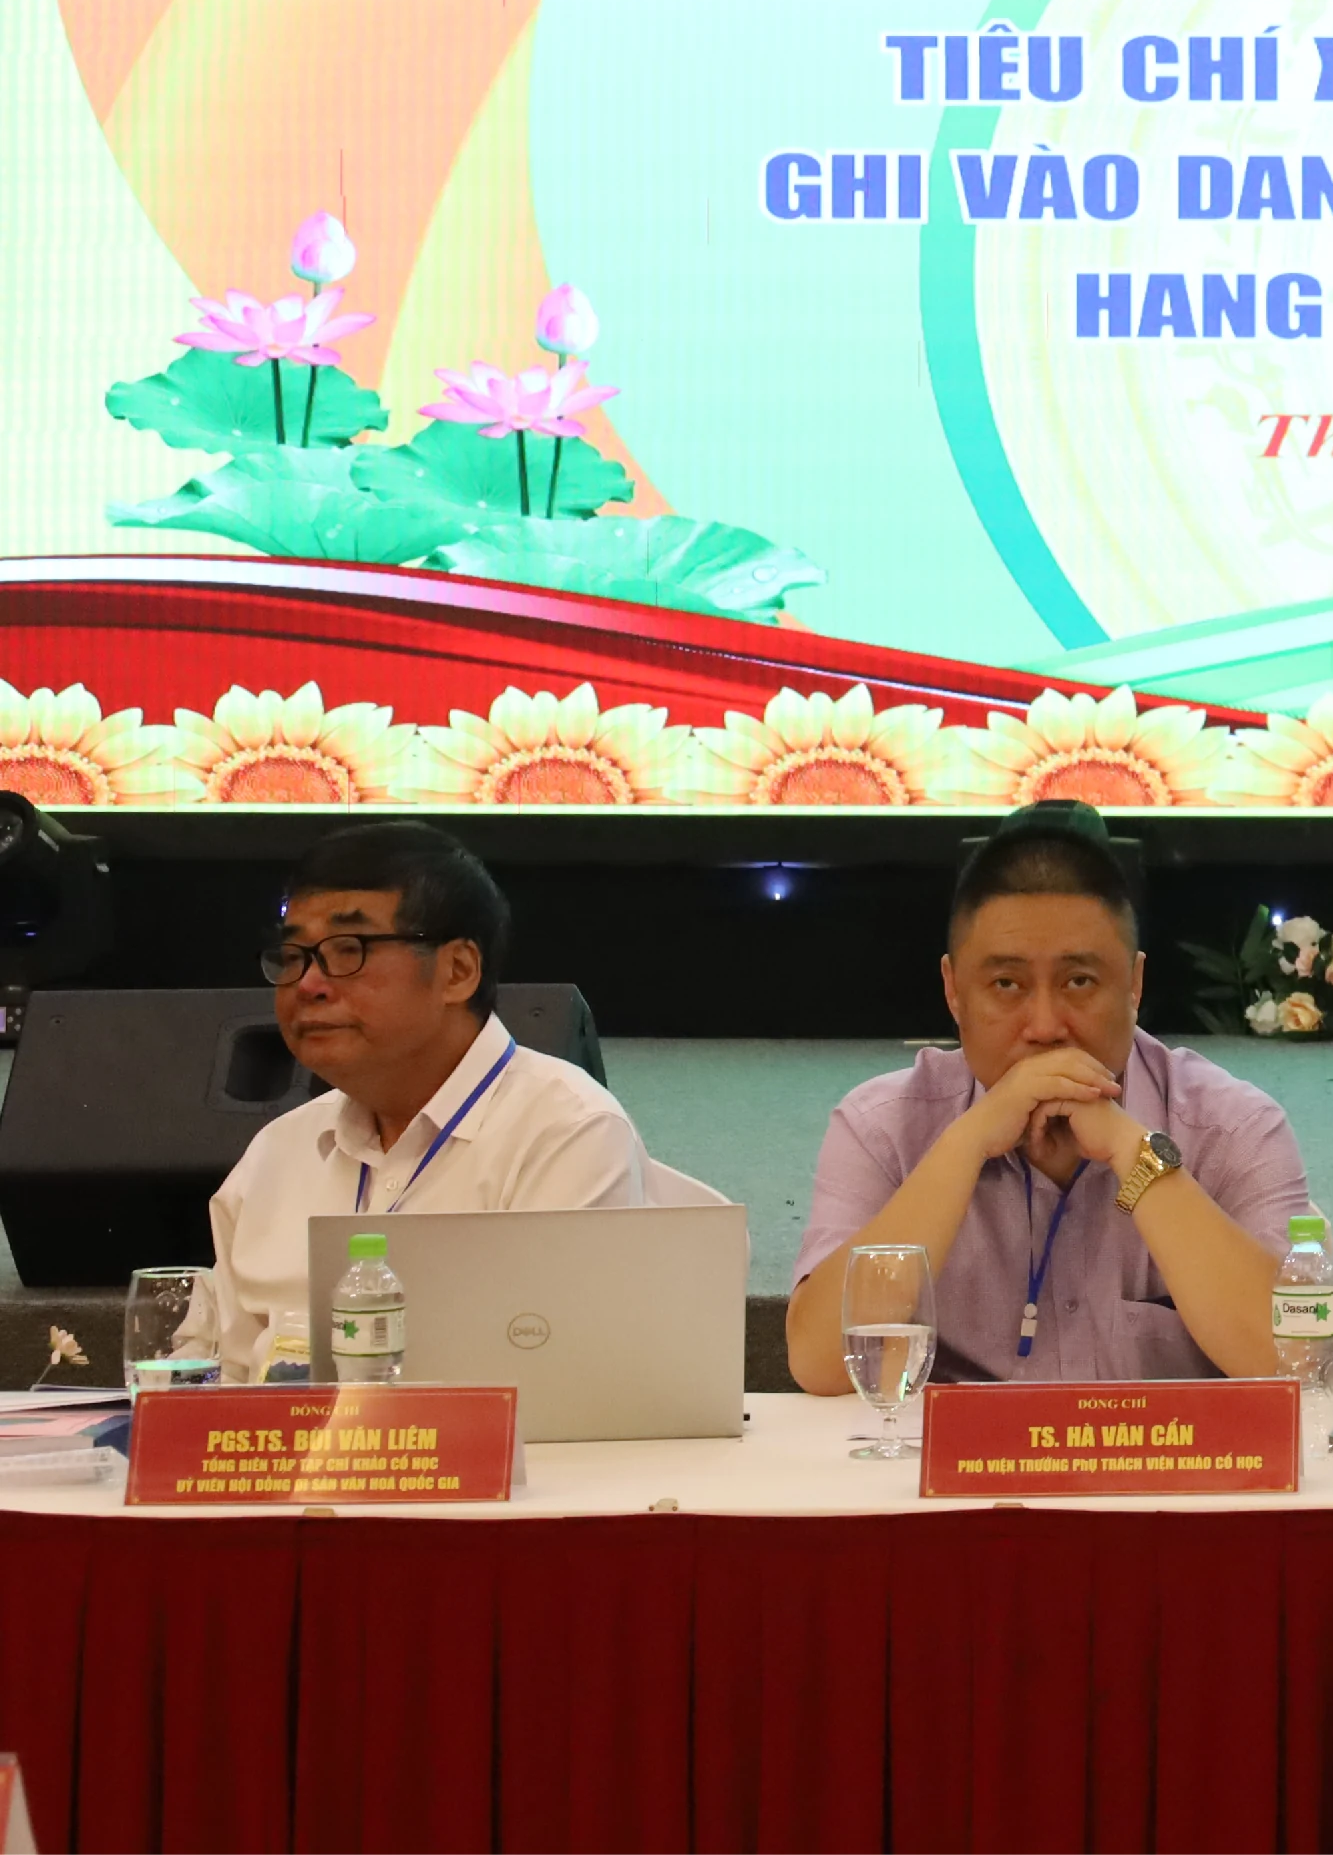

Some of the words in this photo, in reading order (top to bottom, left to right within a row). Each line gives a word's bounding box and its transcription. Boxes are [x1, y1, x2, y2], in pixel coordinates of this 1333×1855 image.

[885, 23, 1083, 103] TIÊU
[1122, 25, 1280, 103] CHÍ
[765, 152, 922, 221] GHI
[956, 144, 1139, 221] VÀO
[1076, 272, 1322, 340] HANG
[207, 1429, 287, 1452] PGS.TS.
[338, 1425, 381, 1451] VĂN
[1028, 1426, 1060, 1447] TS.
[1066, 1423, 1096, 1447] HÀ
[1101, 1422, 1144, 1447] VĂN
